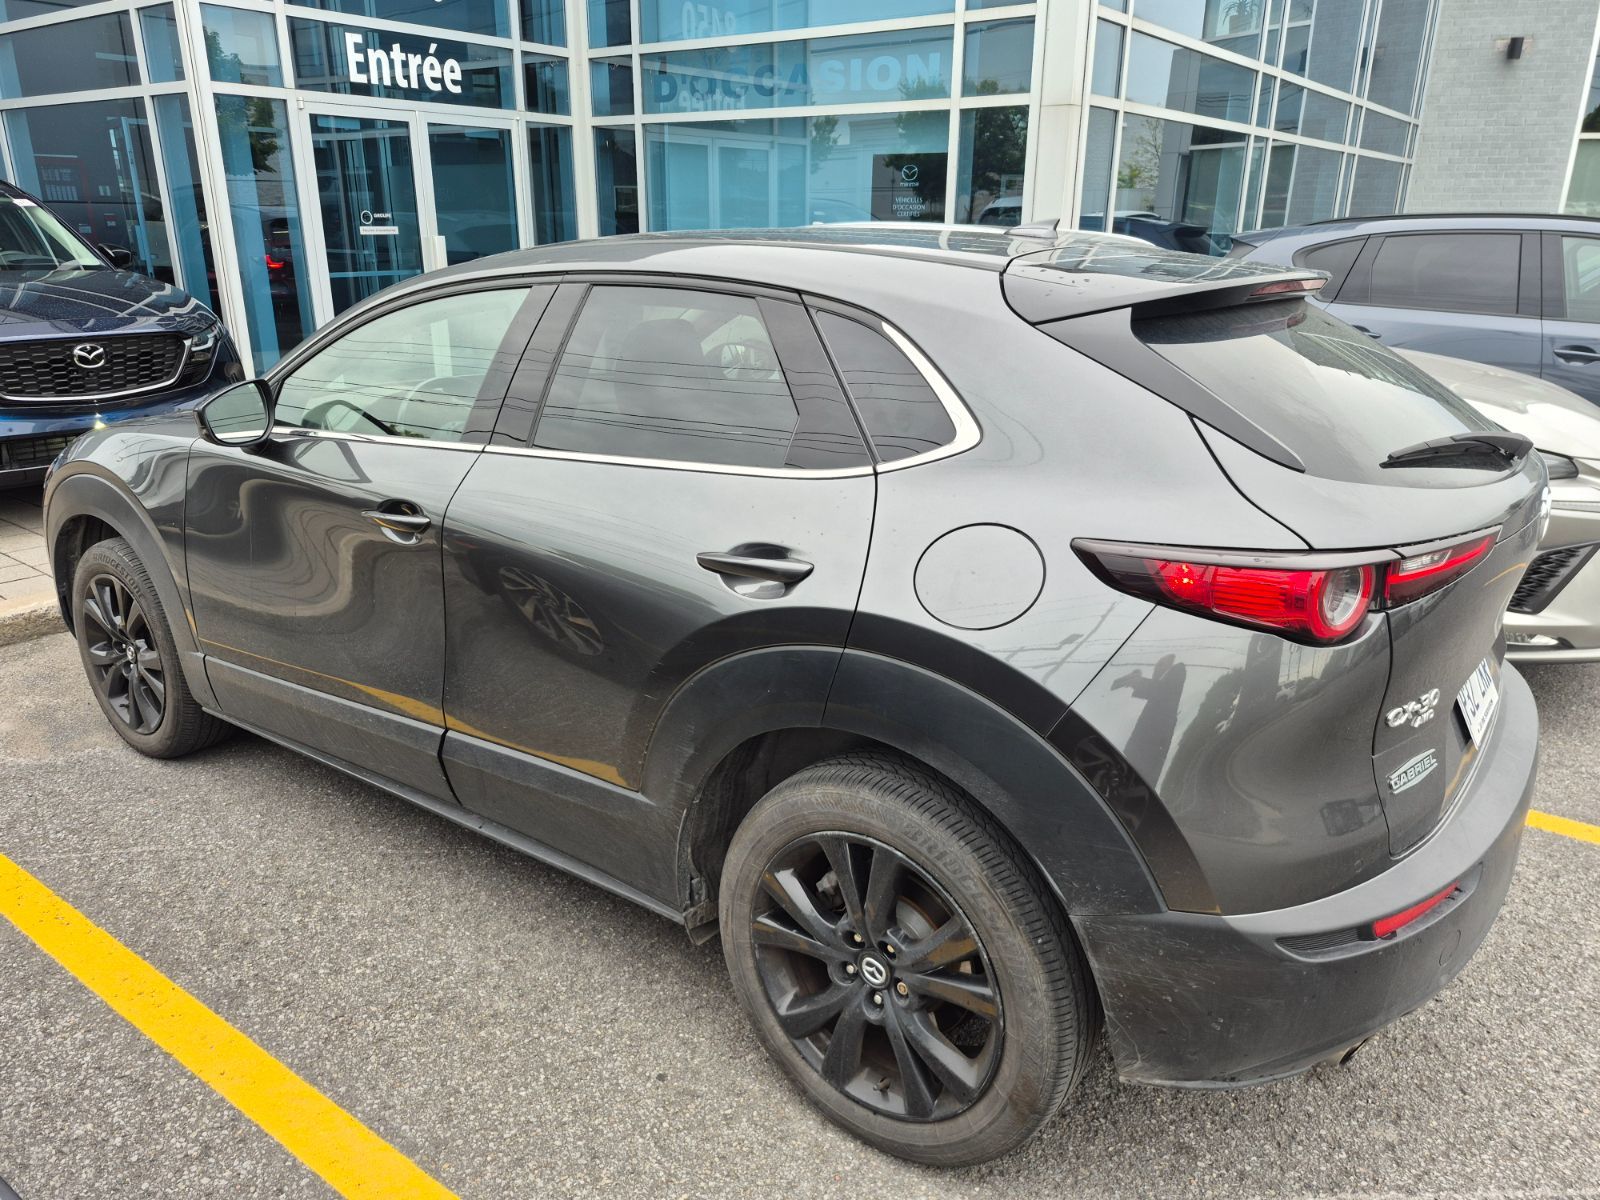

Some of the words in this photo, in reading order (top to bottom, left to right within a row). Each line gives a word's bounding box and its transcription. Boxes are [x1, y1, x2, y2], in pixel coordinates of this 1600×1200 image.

[345, 32, 462, 94] Entrée
[1386, 688, 1440, 728] CX-30
[1389, 755, 1436, 790] GABRIEL
